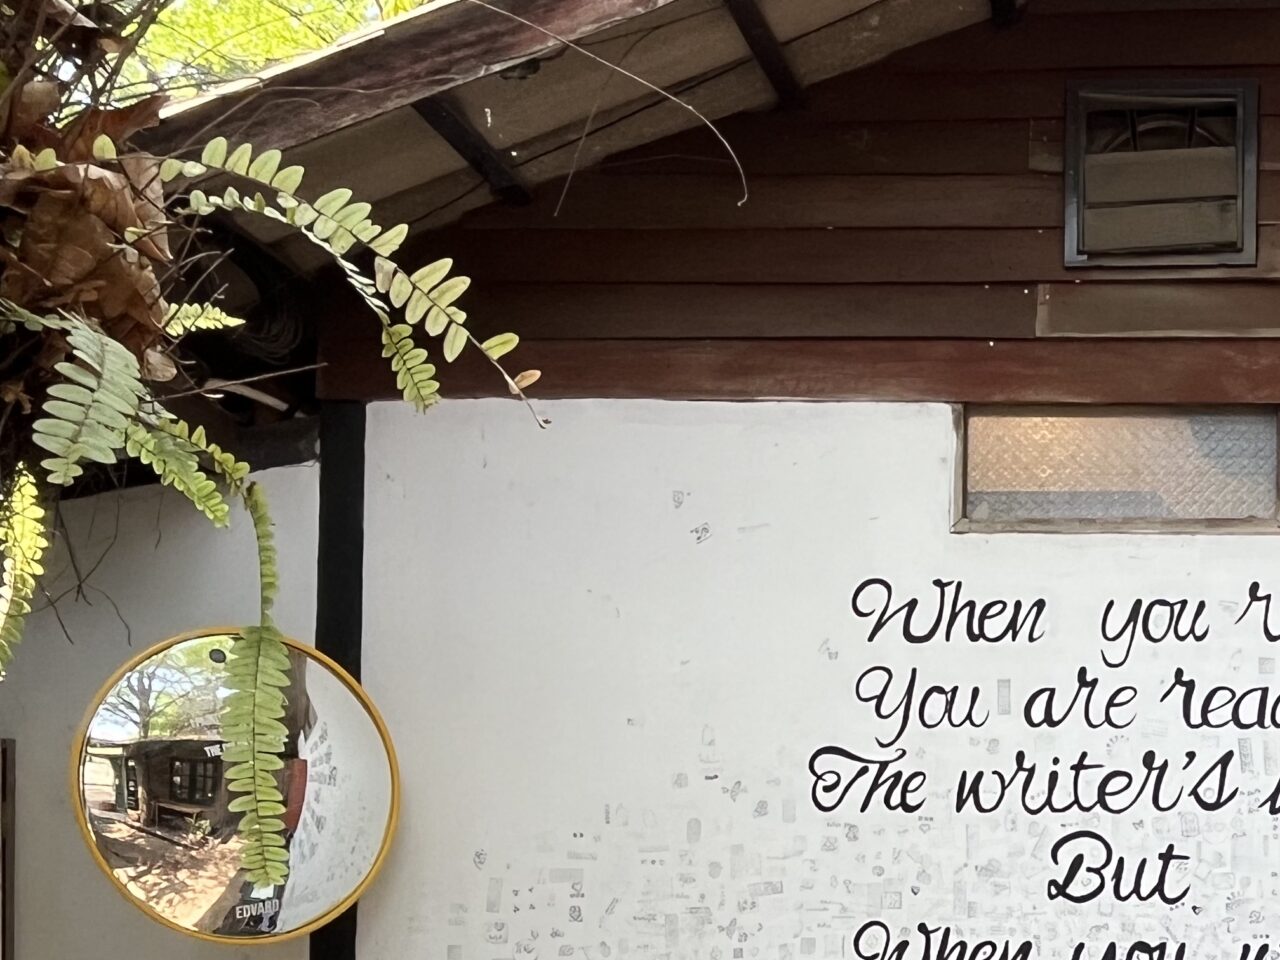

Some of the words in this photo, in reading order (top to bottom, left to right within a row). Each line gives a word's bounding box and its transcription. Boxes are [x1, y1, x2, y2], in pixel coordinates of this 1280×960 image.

[852, 578, 1046, 644] When
[1101, 599, 1209, 668] you
[855, 666, 990, 749] You
[1023, 667, 1138, 729] are
[808, 745, 927, 814] The
[955, 750, 1239, 816] writer's
[1047, 830, 1193, 905] But
